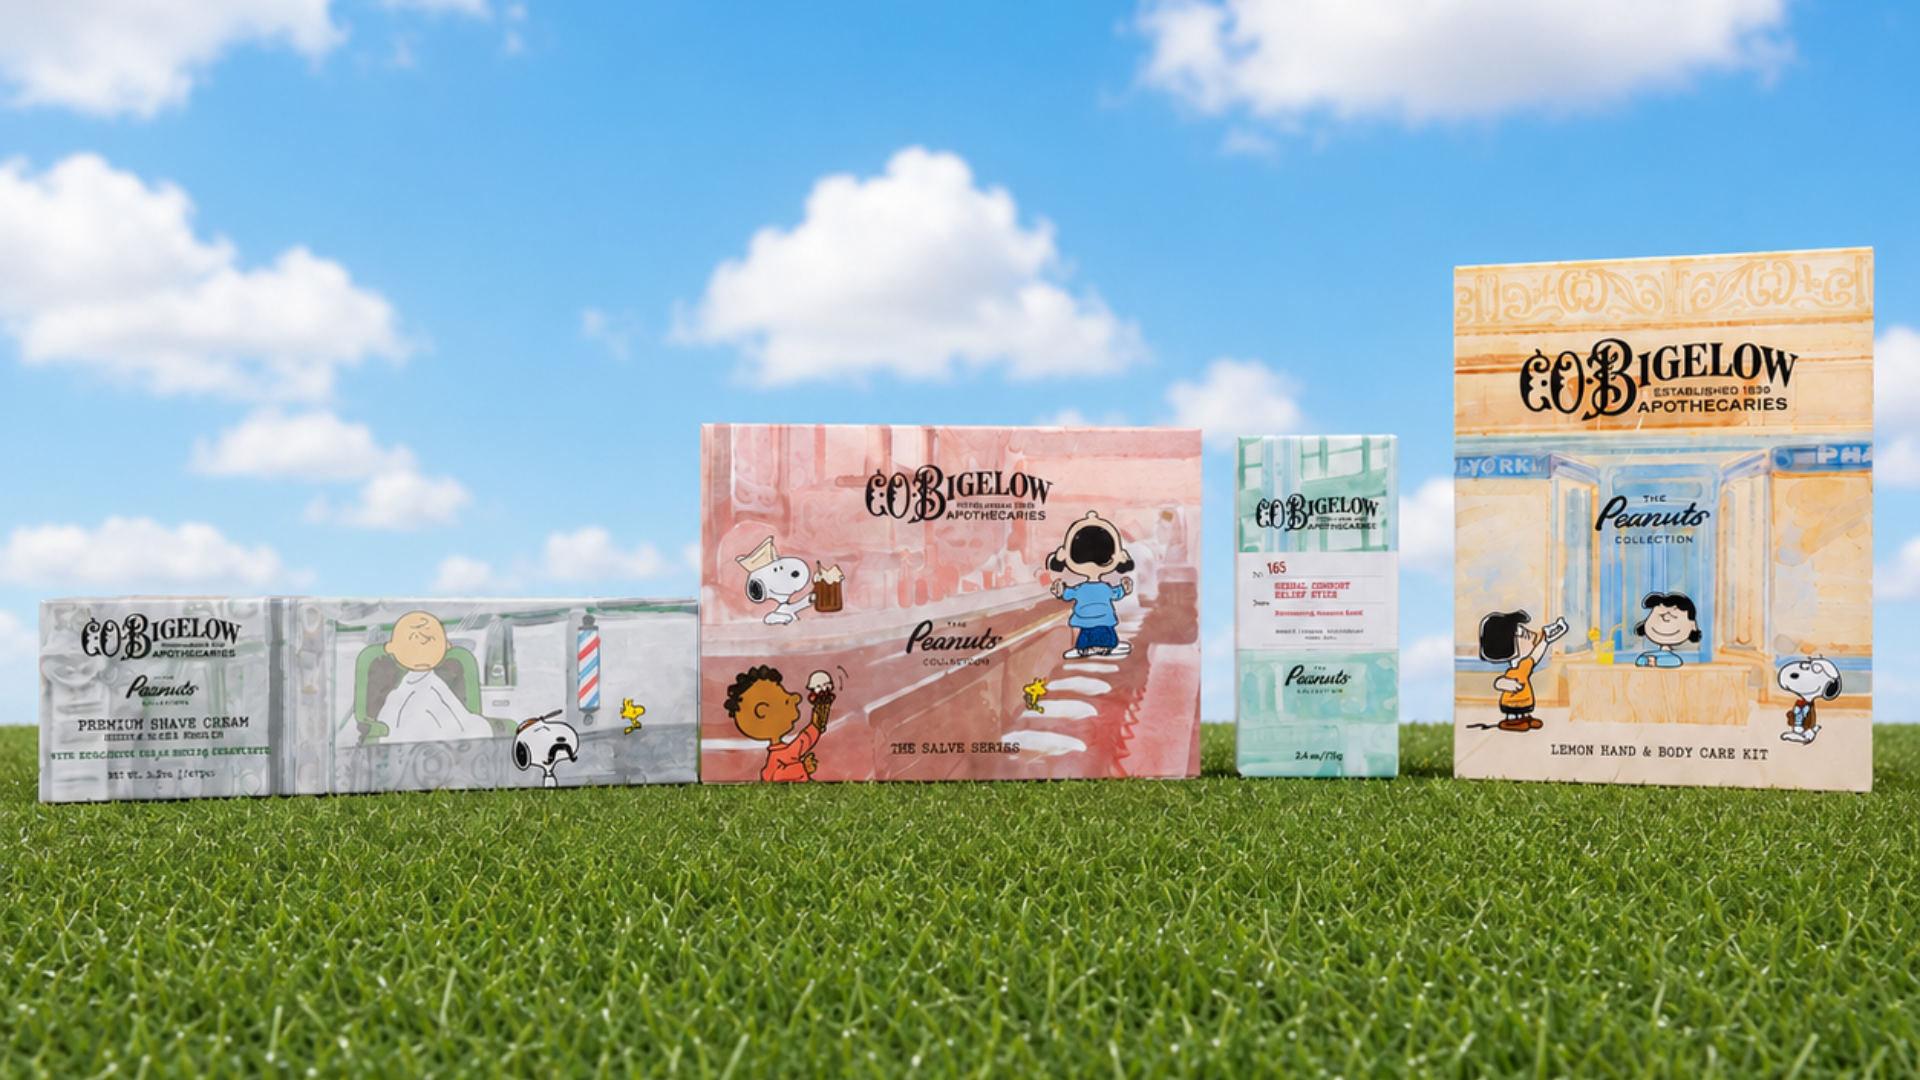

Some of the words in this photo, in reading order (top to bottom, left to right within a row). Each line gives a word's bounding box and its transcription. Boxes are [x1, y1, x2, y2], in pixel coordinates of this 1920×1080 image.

[1653, 386, 1739, 397] ESTABLISHED
[1637, 397, 1788, 414] APOTHECARIES
[1642, 494, 1667, 503] THE
[946, 510, 1047, 521] APOTHECARIES
[1595, 495, 1711, 532] Peanuts
[1614, 534, 1694, 544] COLLECTION
[1266, 561, 1287, 575] 165
[906, 619, 1001, 654] Peanuts
[1284, 664, 1351, 687] Peanuts
[77, 719, 144, 732] PREMIUM
[151, 717, 197, 730] SHAVE
[203, 716, 250, 729] CREAM
[890, 743, 916, 755] THE
[921, 742, 965, 754] SALVE
[971, 742, 1021, 754] SERIES
[1550, 743, 1594, 756] LEMON
[1600, 745, 1637, 757] HAND
[1642, 746, 1652, 757] &
[1658, 746, 1693, 758] BODY
[1700, 747, 1736, 760] CARE
[1743, 748, 1769, 760] KIT
